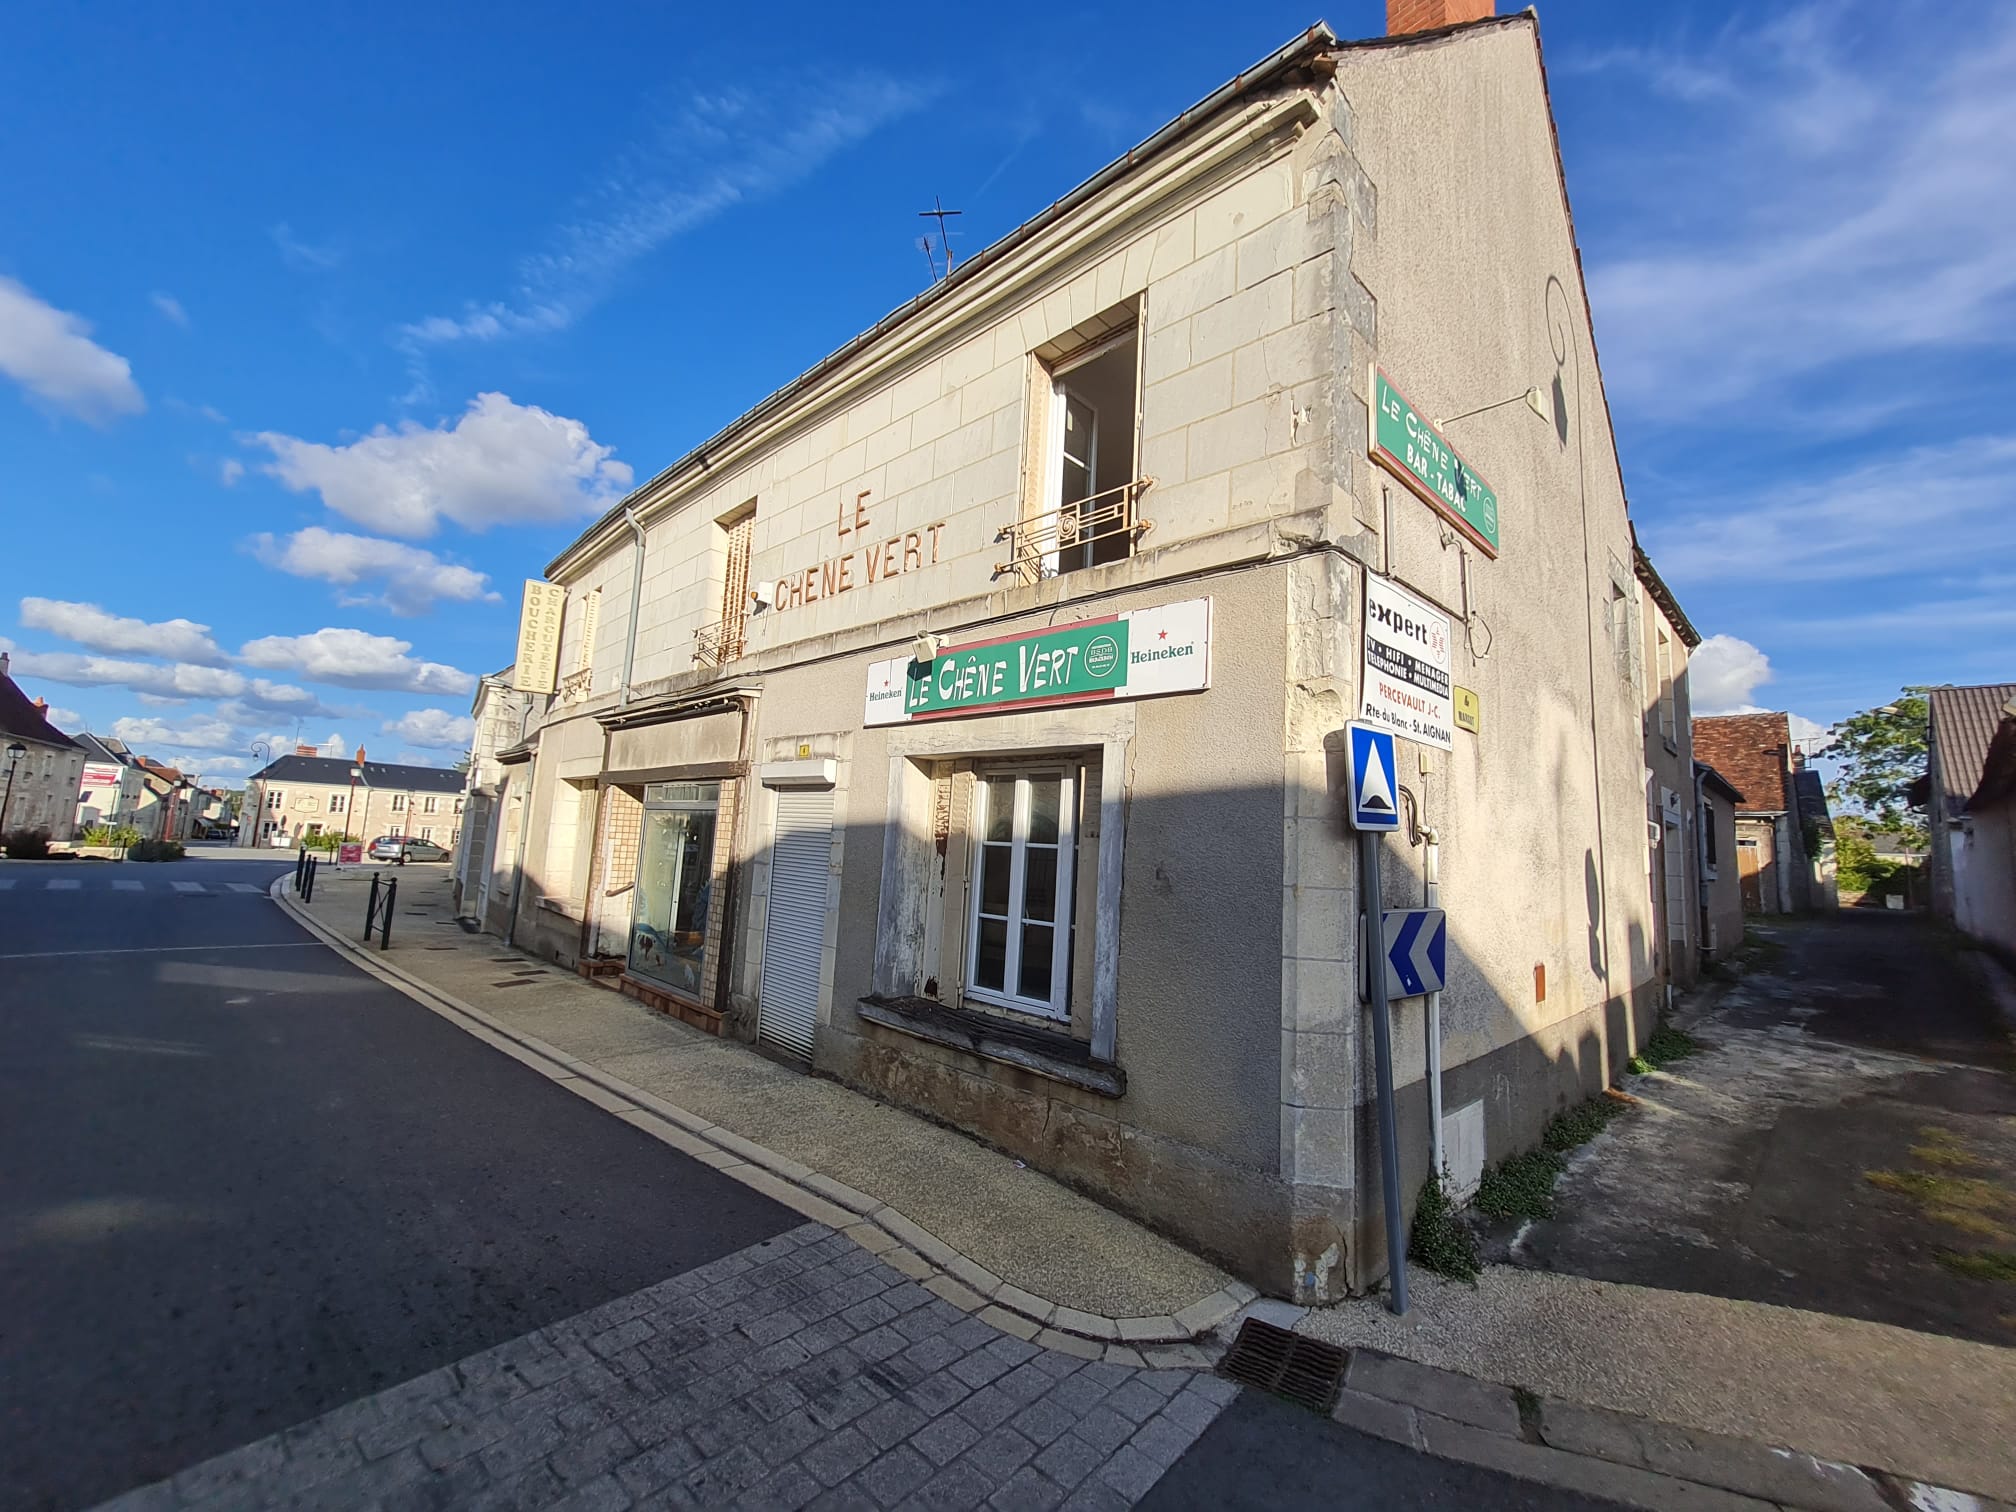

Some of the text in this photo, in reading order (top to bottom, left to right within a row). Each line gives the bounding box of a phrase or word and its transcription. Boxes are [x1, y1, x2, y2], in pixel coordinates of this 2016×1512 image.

[1382, 385, 1482, 501] LE CHÊNE VERT
[1407, 443, 1466, 513] BAR TABAC
[837, 489, 872, 536] LE
[775, 520, 946, 612] CHENE VERT
[520, 584, 542, 687] BOUCHERIE
[1369, 598, 1428, 645] expert
[910, 643, 1078, 708] LE CHÊNE VERT
[1131, 645, 1193, 664] Heineken
[1367, 637, 1449, 686] TV HIFI MENAGER
[1367, 650, 1449, 697] TELEPHONIE MULTIMEDIA
[870, 687, 902, 701] Heineken
[1379, 682, 1425, 713] PERCEVAULT
[1391, 712, 1408, 730] Blanc
[1422, 722, 1451, 744] AIGNAN
